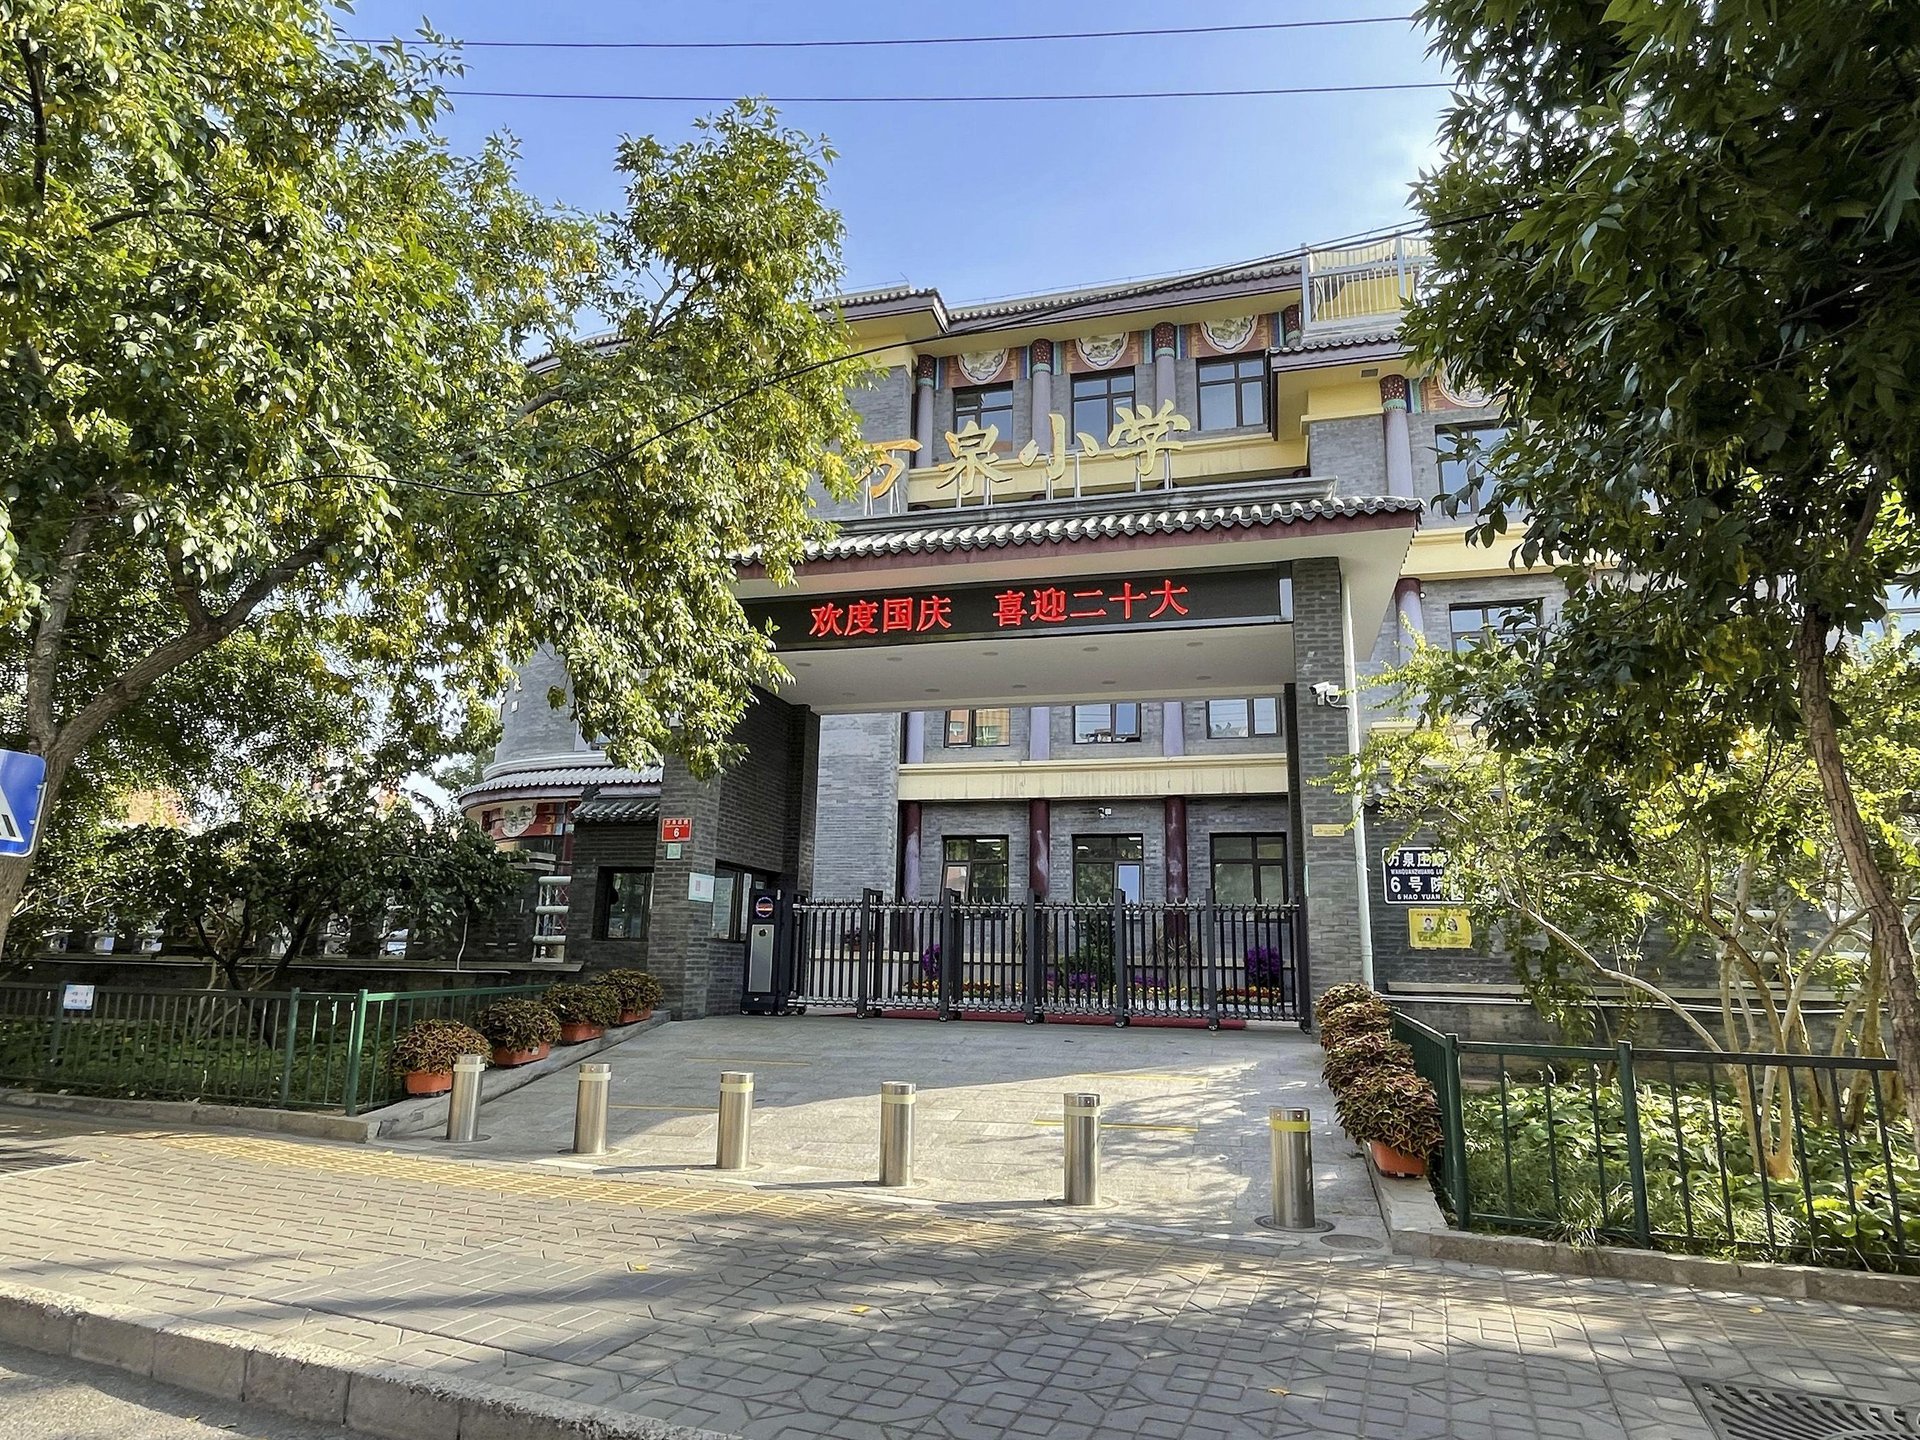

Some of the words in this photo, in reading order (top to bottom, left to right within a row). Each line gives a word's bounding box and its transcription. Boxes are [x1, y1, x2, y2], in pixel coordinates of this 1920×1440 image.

[854, 399, 1191, 498] 万泉小学
[808, 595, 953, 638] 欢度国庆
[992, 579, 1190, 627] 喜迎二十大
[673, 828, 680, 837] 6
